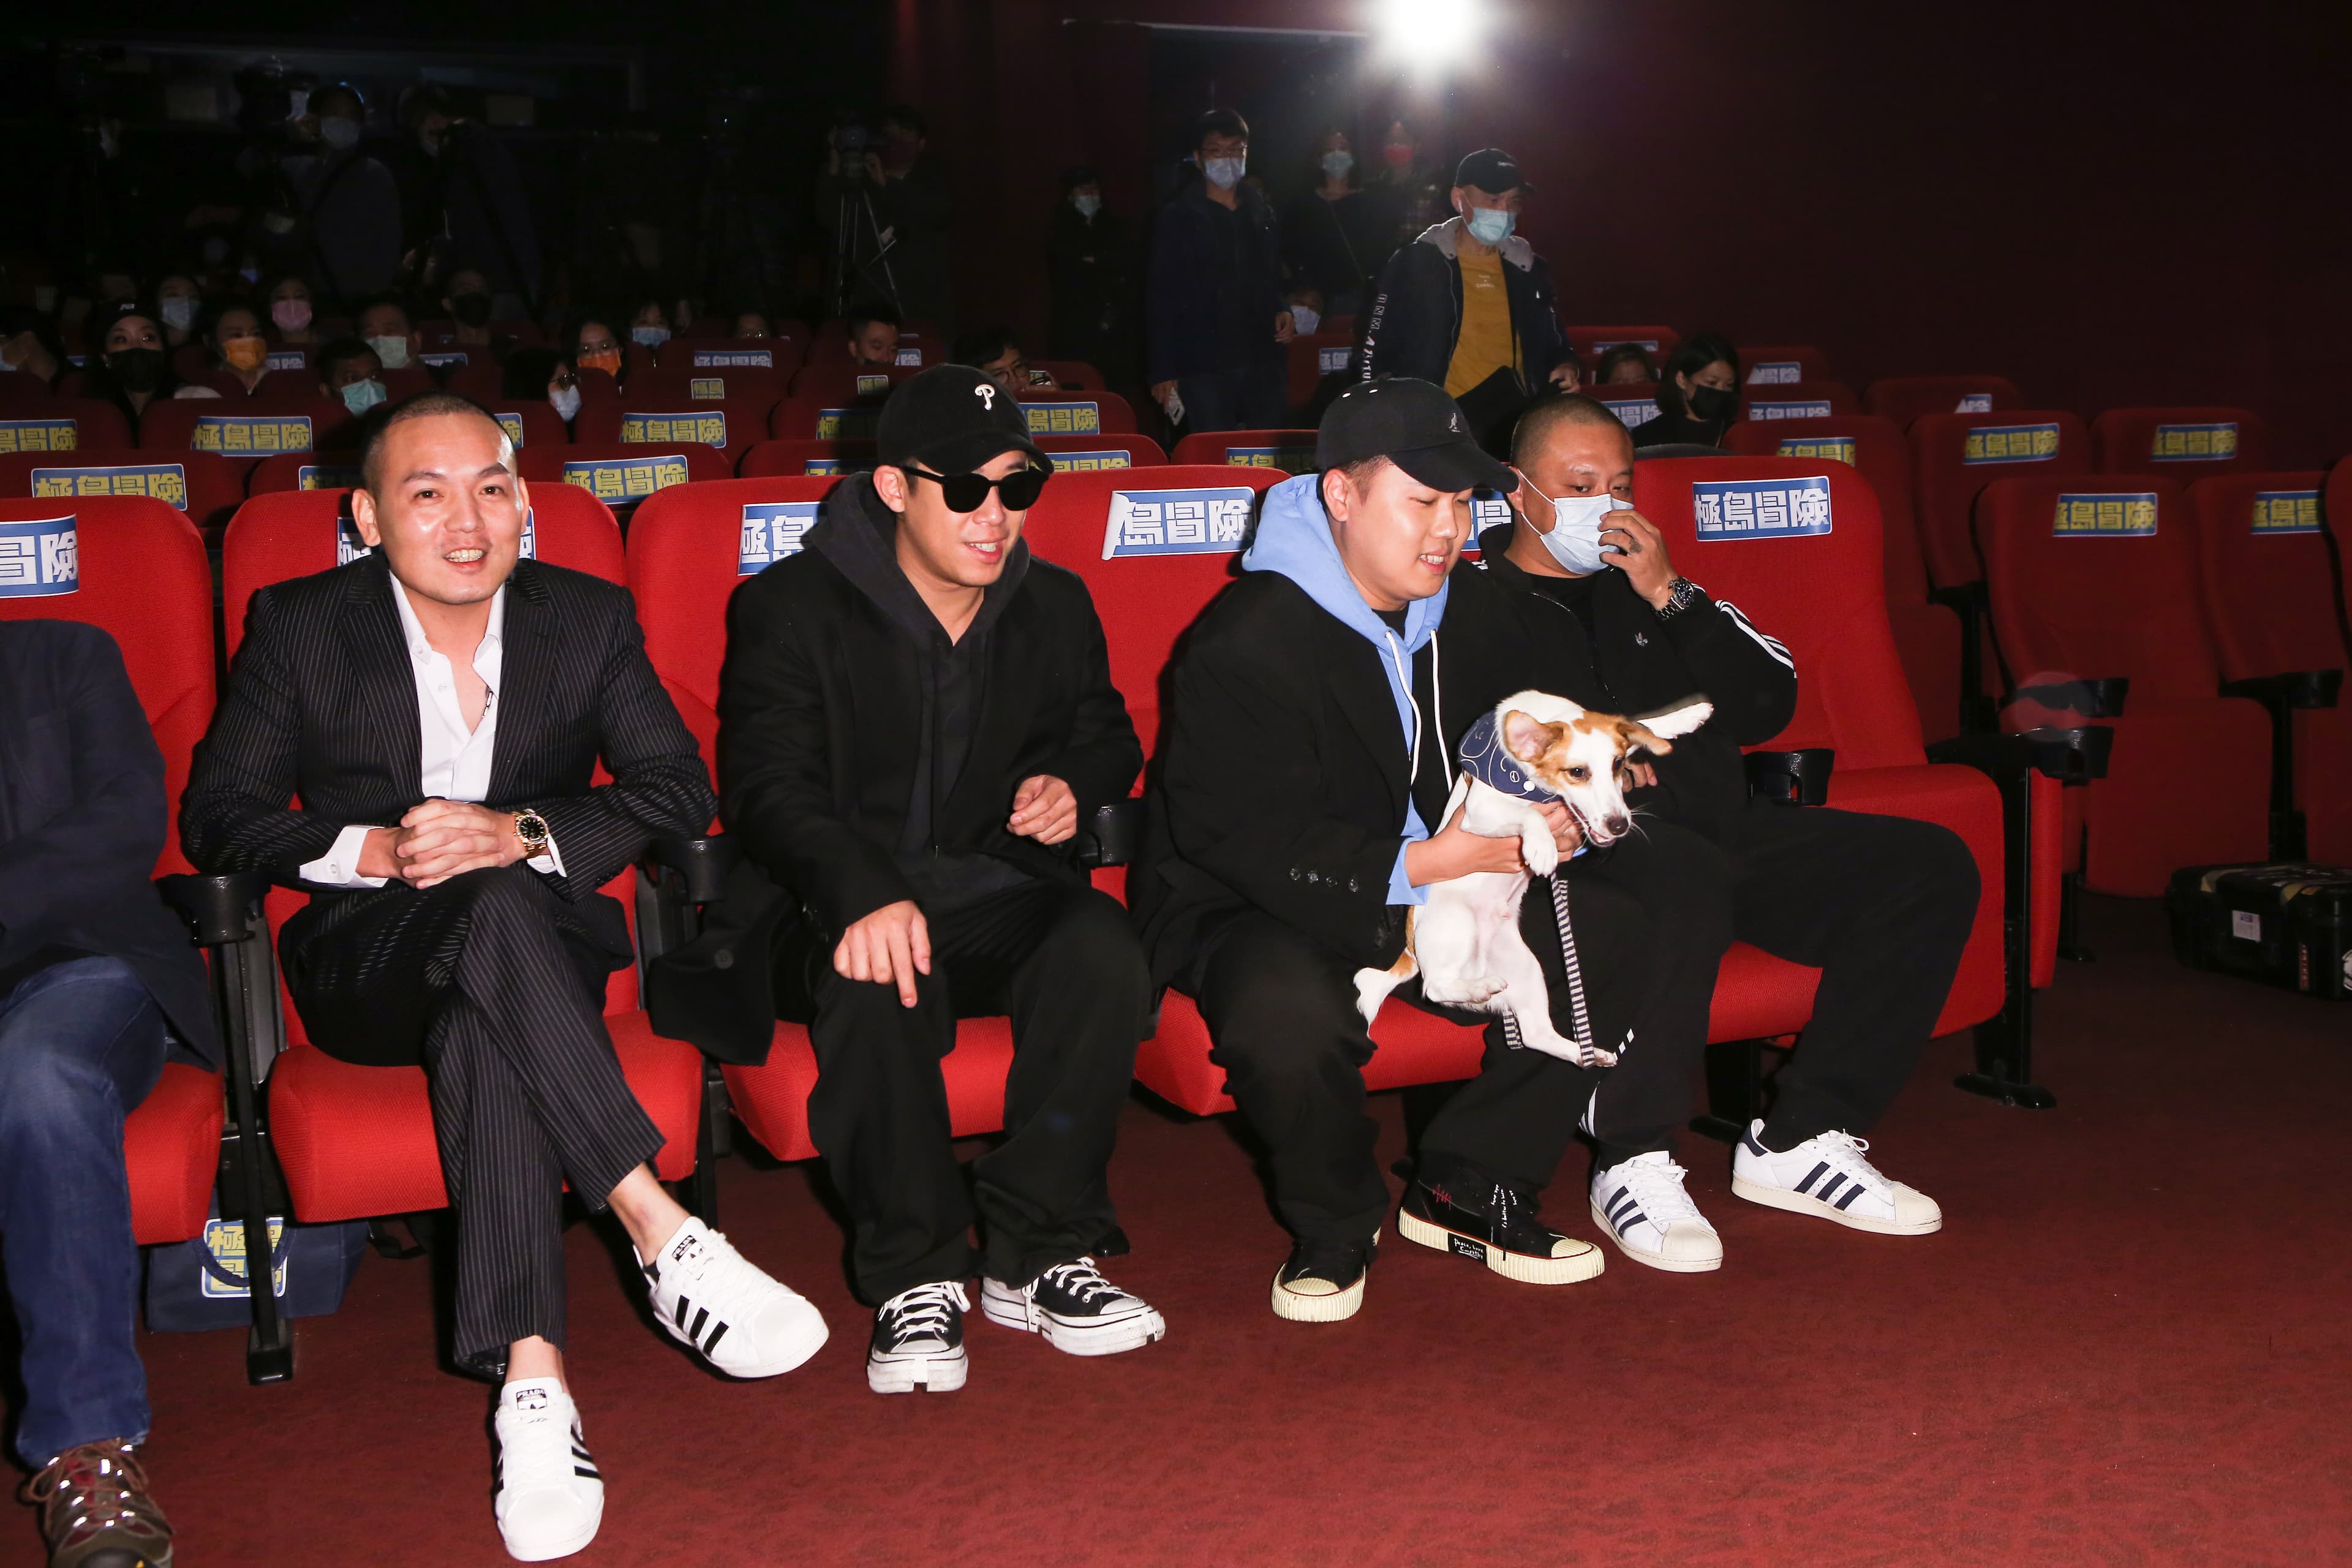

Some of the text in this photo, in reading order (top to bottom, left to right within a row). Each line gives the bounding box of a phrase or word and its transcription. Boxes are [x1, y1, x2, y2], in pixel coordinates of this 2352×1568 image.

[974, 384, 995, 410] P
[194, 423, 309, 450] 極島冒險
[621, 418, 724, 442] 極島冒險
[564, 464, 687, 497] 極島冒險
[1695, 488, 1830, 532] 極島冒險
